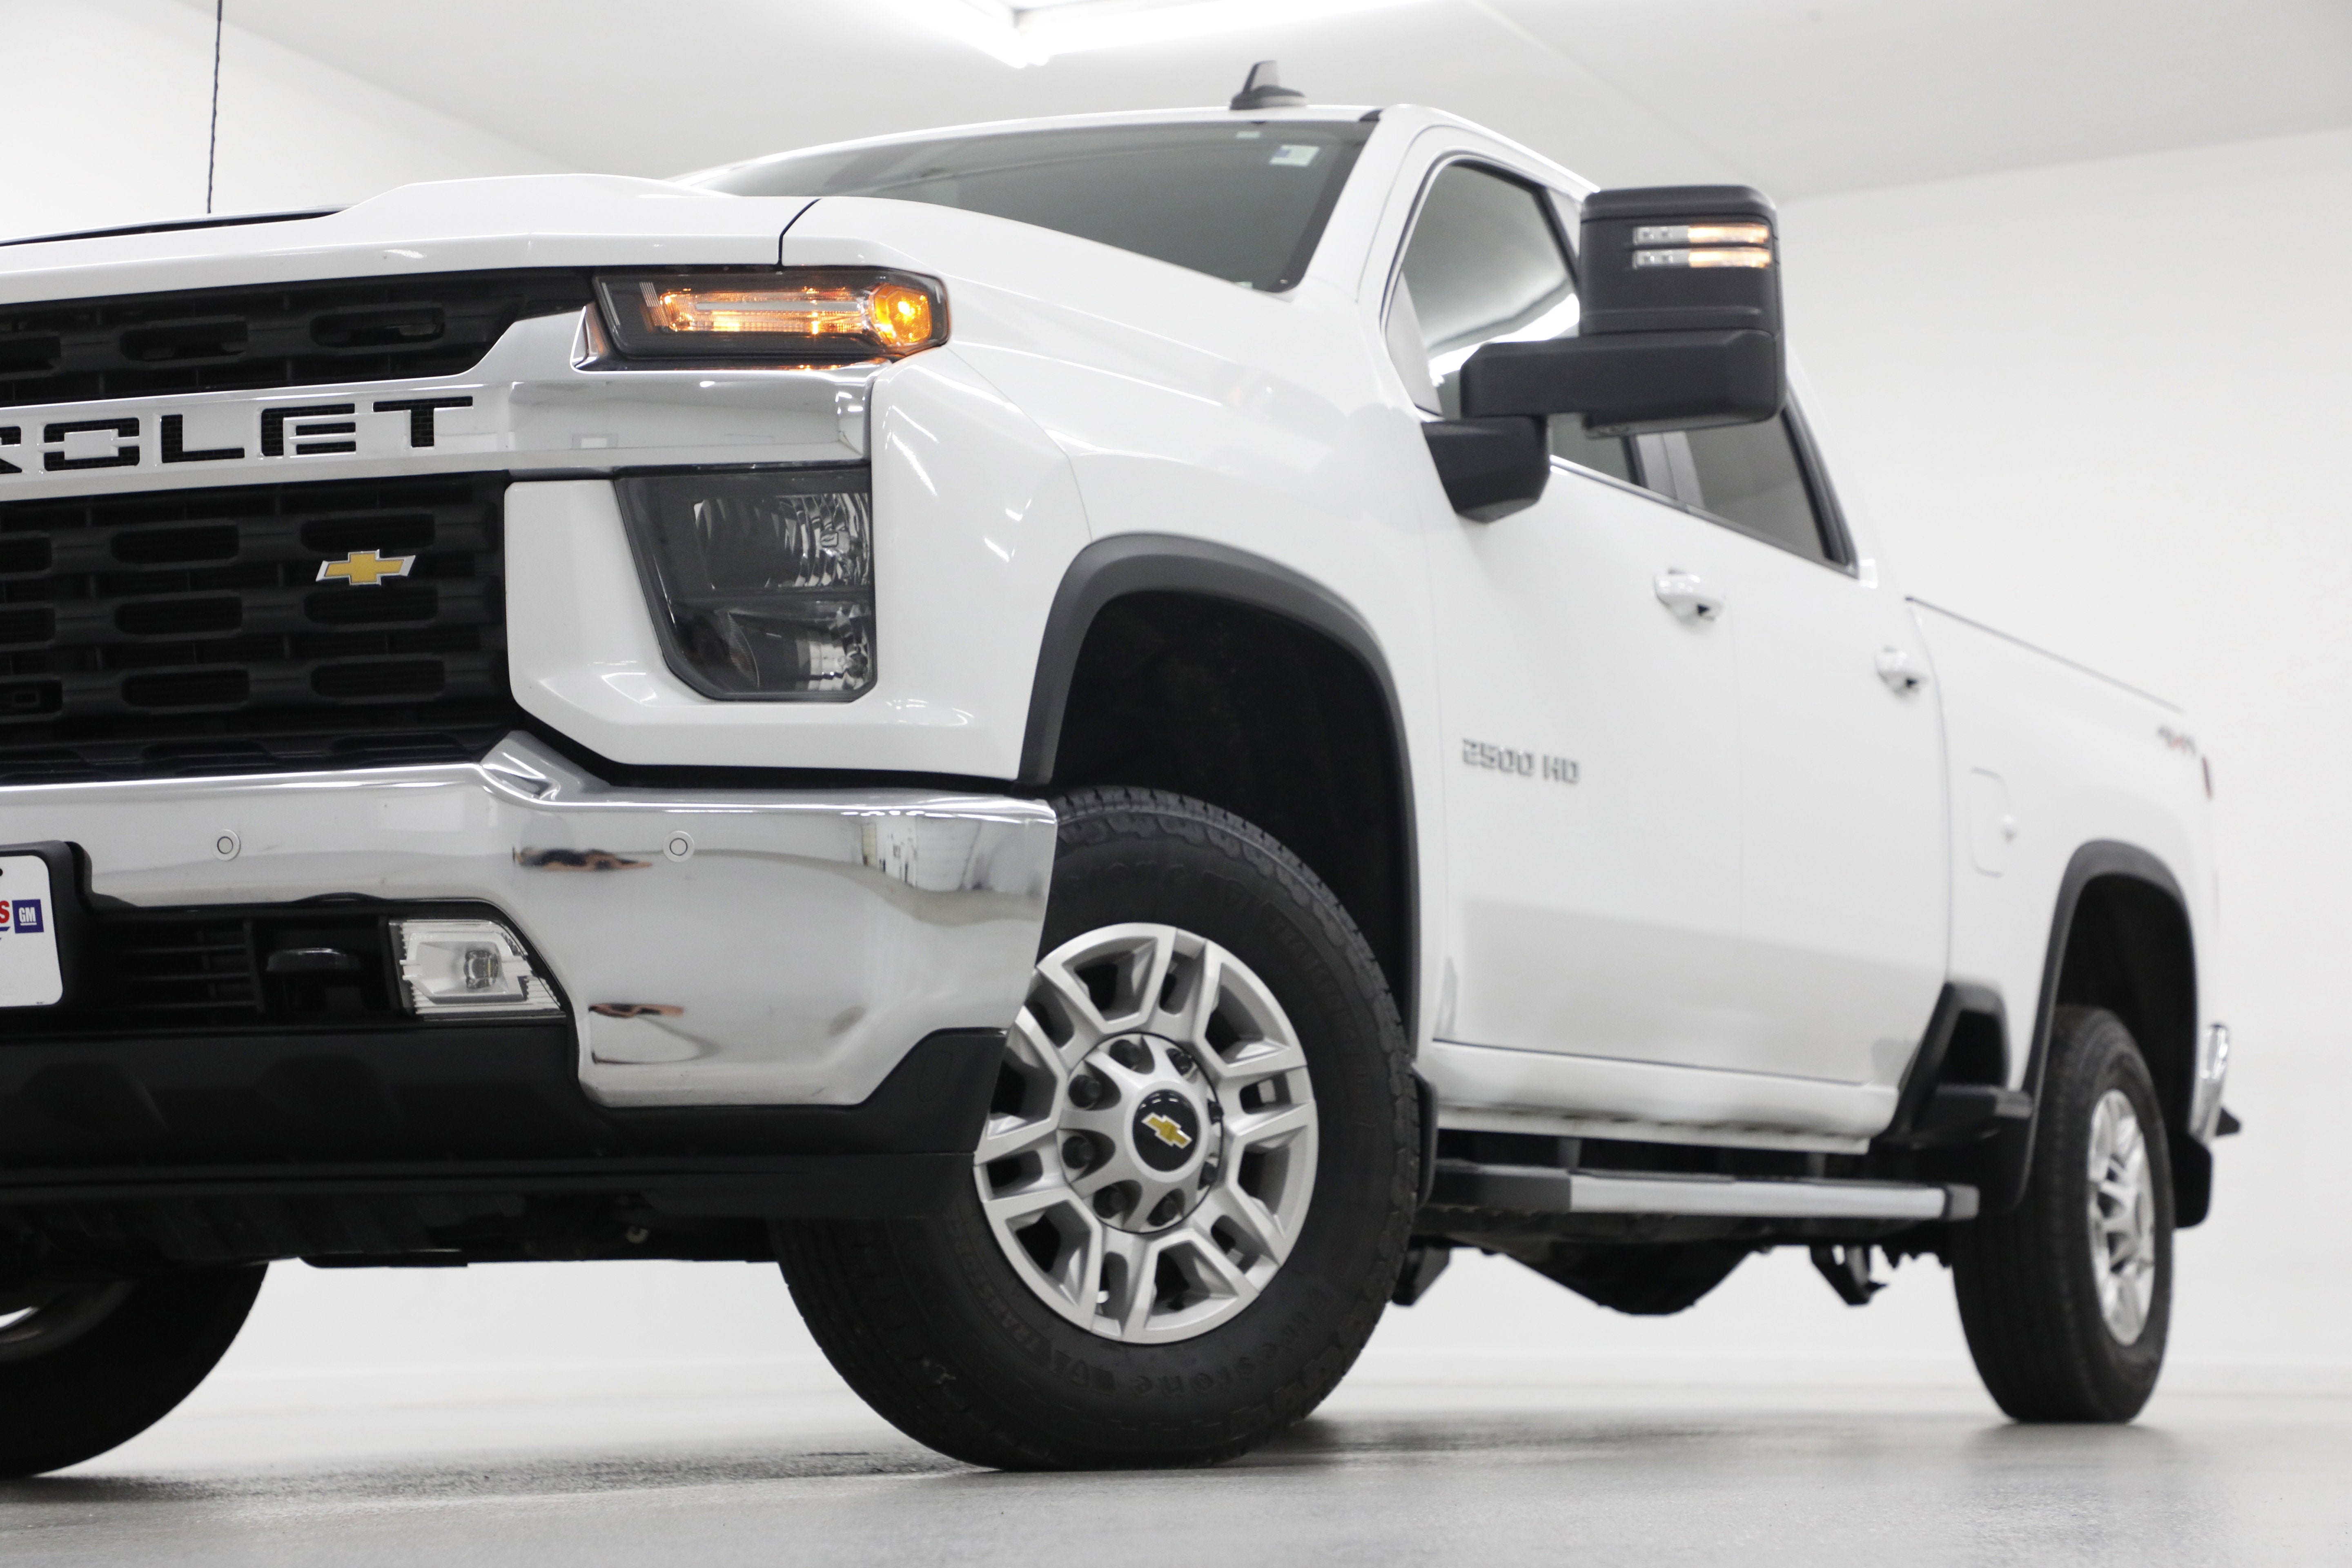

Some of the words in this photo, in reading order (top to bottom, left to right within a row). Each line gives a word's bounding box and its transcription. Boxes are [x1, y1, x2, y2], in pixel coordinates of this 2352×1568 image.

[0, 396, 473, 474] OLET
[1462, 737, 1535, 777] 2500
[1542, 754, 1580, 785] HD
[18, 906, 36, 924] GM
